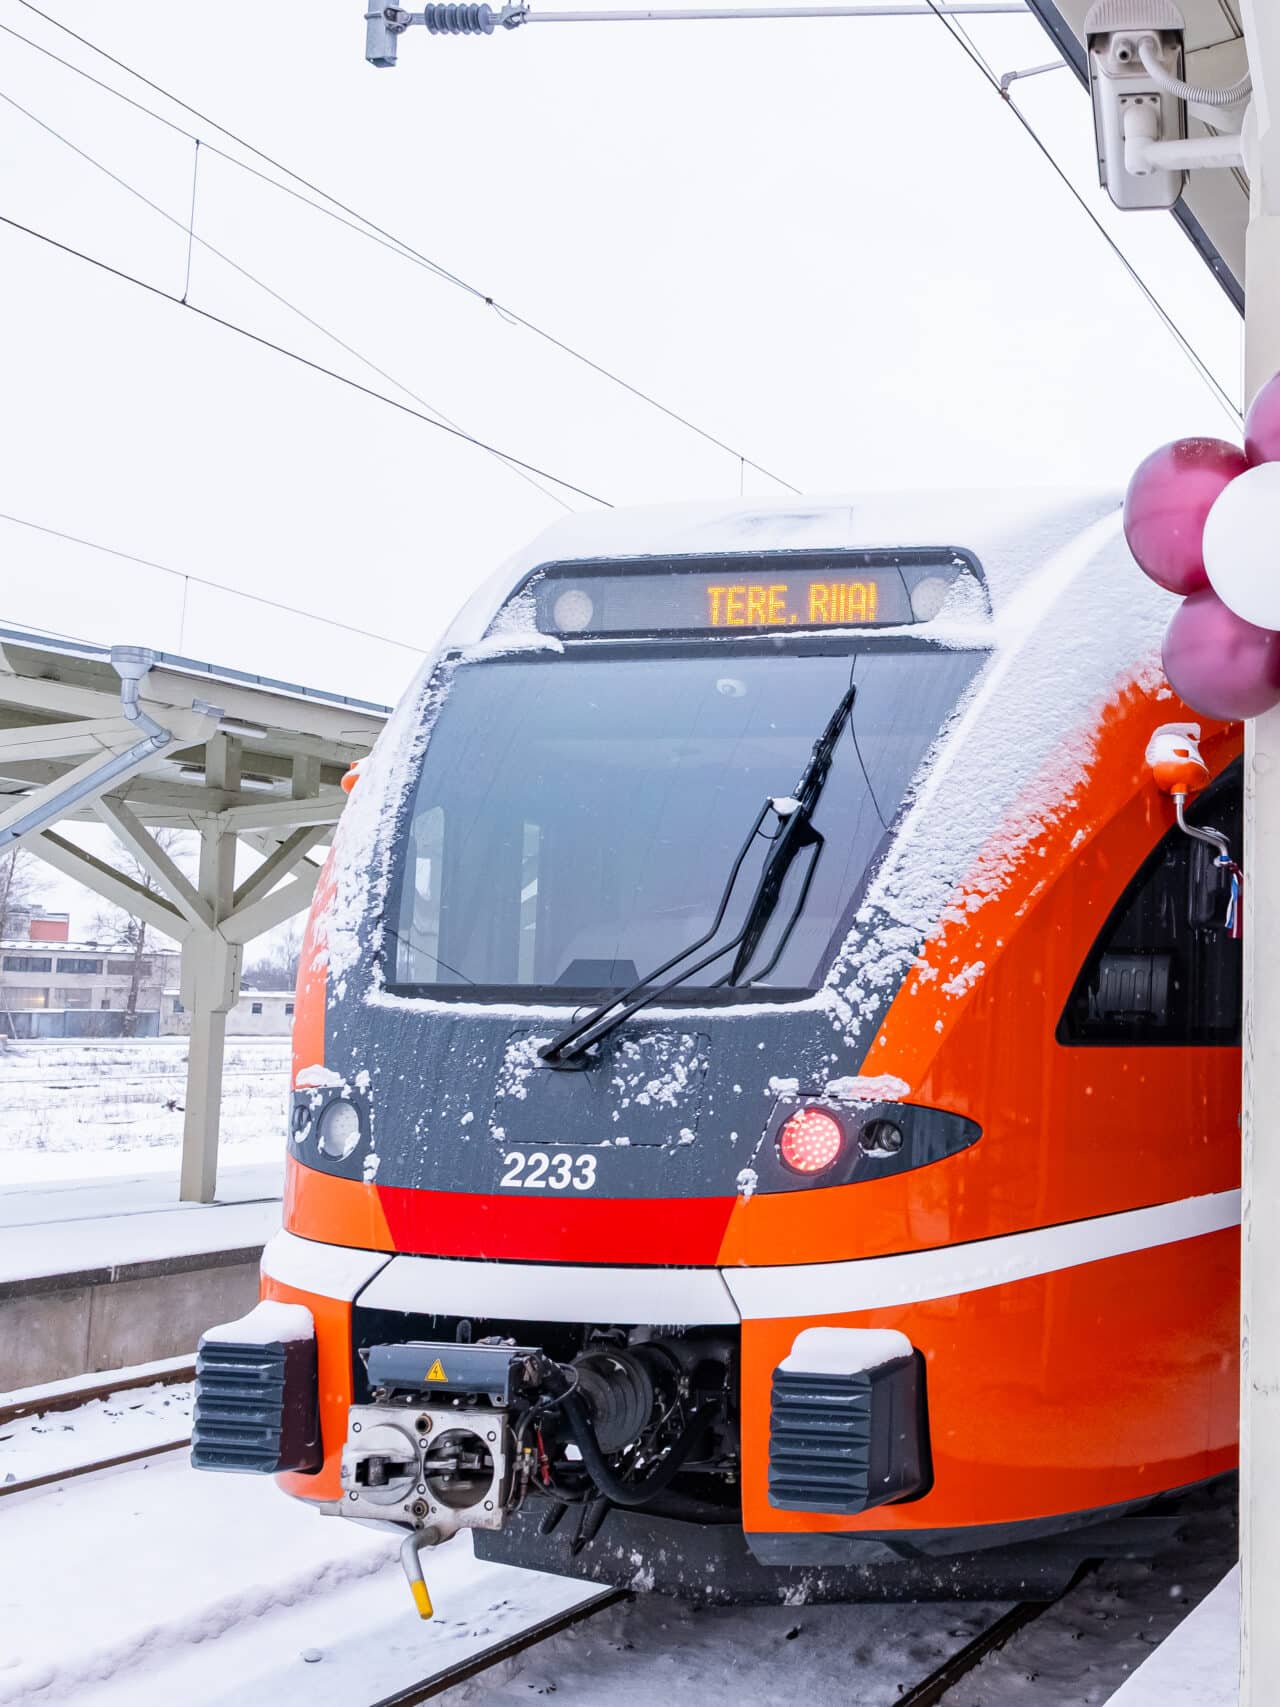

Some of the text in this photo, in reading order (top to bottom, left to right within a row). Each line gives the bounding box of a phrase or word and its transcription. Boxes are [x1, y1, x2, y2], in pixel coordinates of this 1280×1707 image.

[707, 582, 876, 625] TERE, RIIA!
[500, 1151, 597, 1190] 2233
